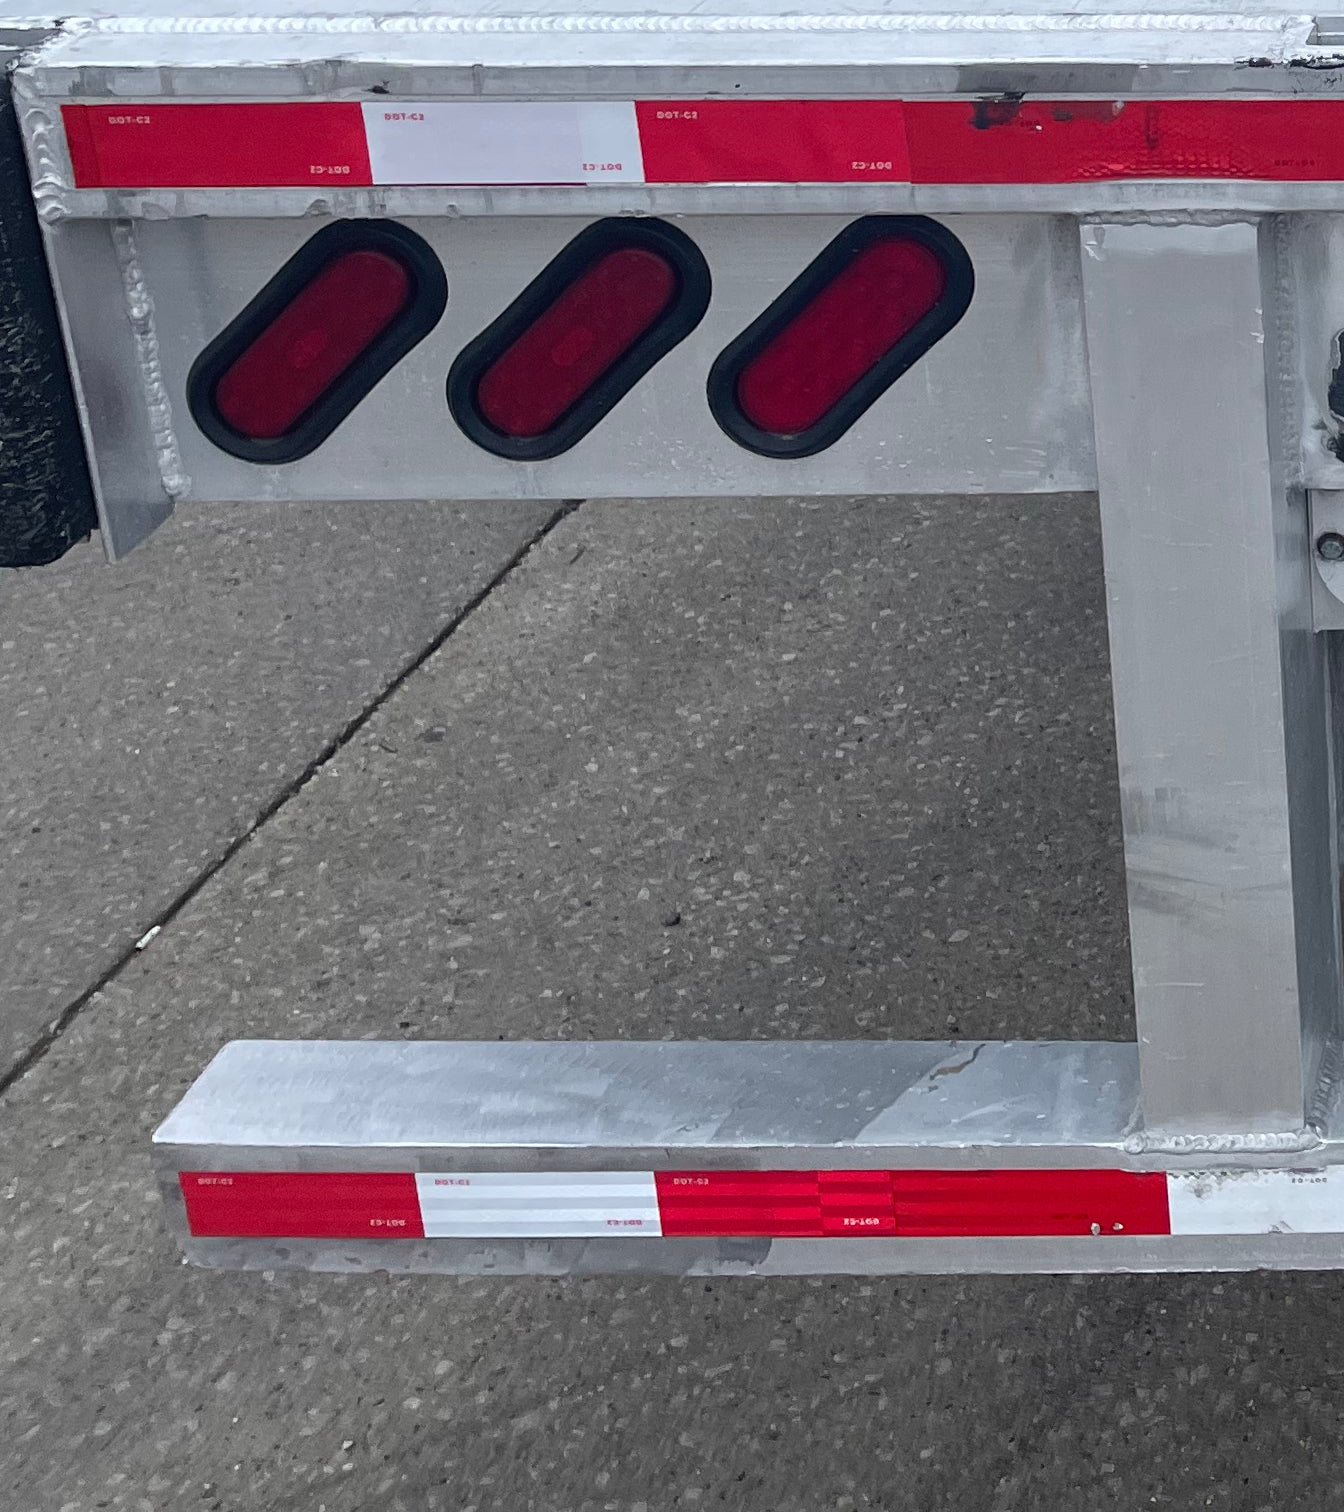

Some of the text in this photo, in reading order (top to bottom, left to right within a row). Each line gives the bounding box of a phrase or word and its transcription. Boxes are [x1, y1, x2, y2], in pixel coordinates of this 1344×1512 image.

[384, 113, 424, 121] DOT-C2
[657, 111, 698, 119] DOT-C2
[109, 116, 150, 124] DOT-C2
[582, 163, 622, 171] DOT-C2
[851, 161, 892, 169] DOT-C2
[309, 165, 351, 174] DOT-C2
